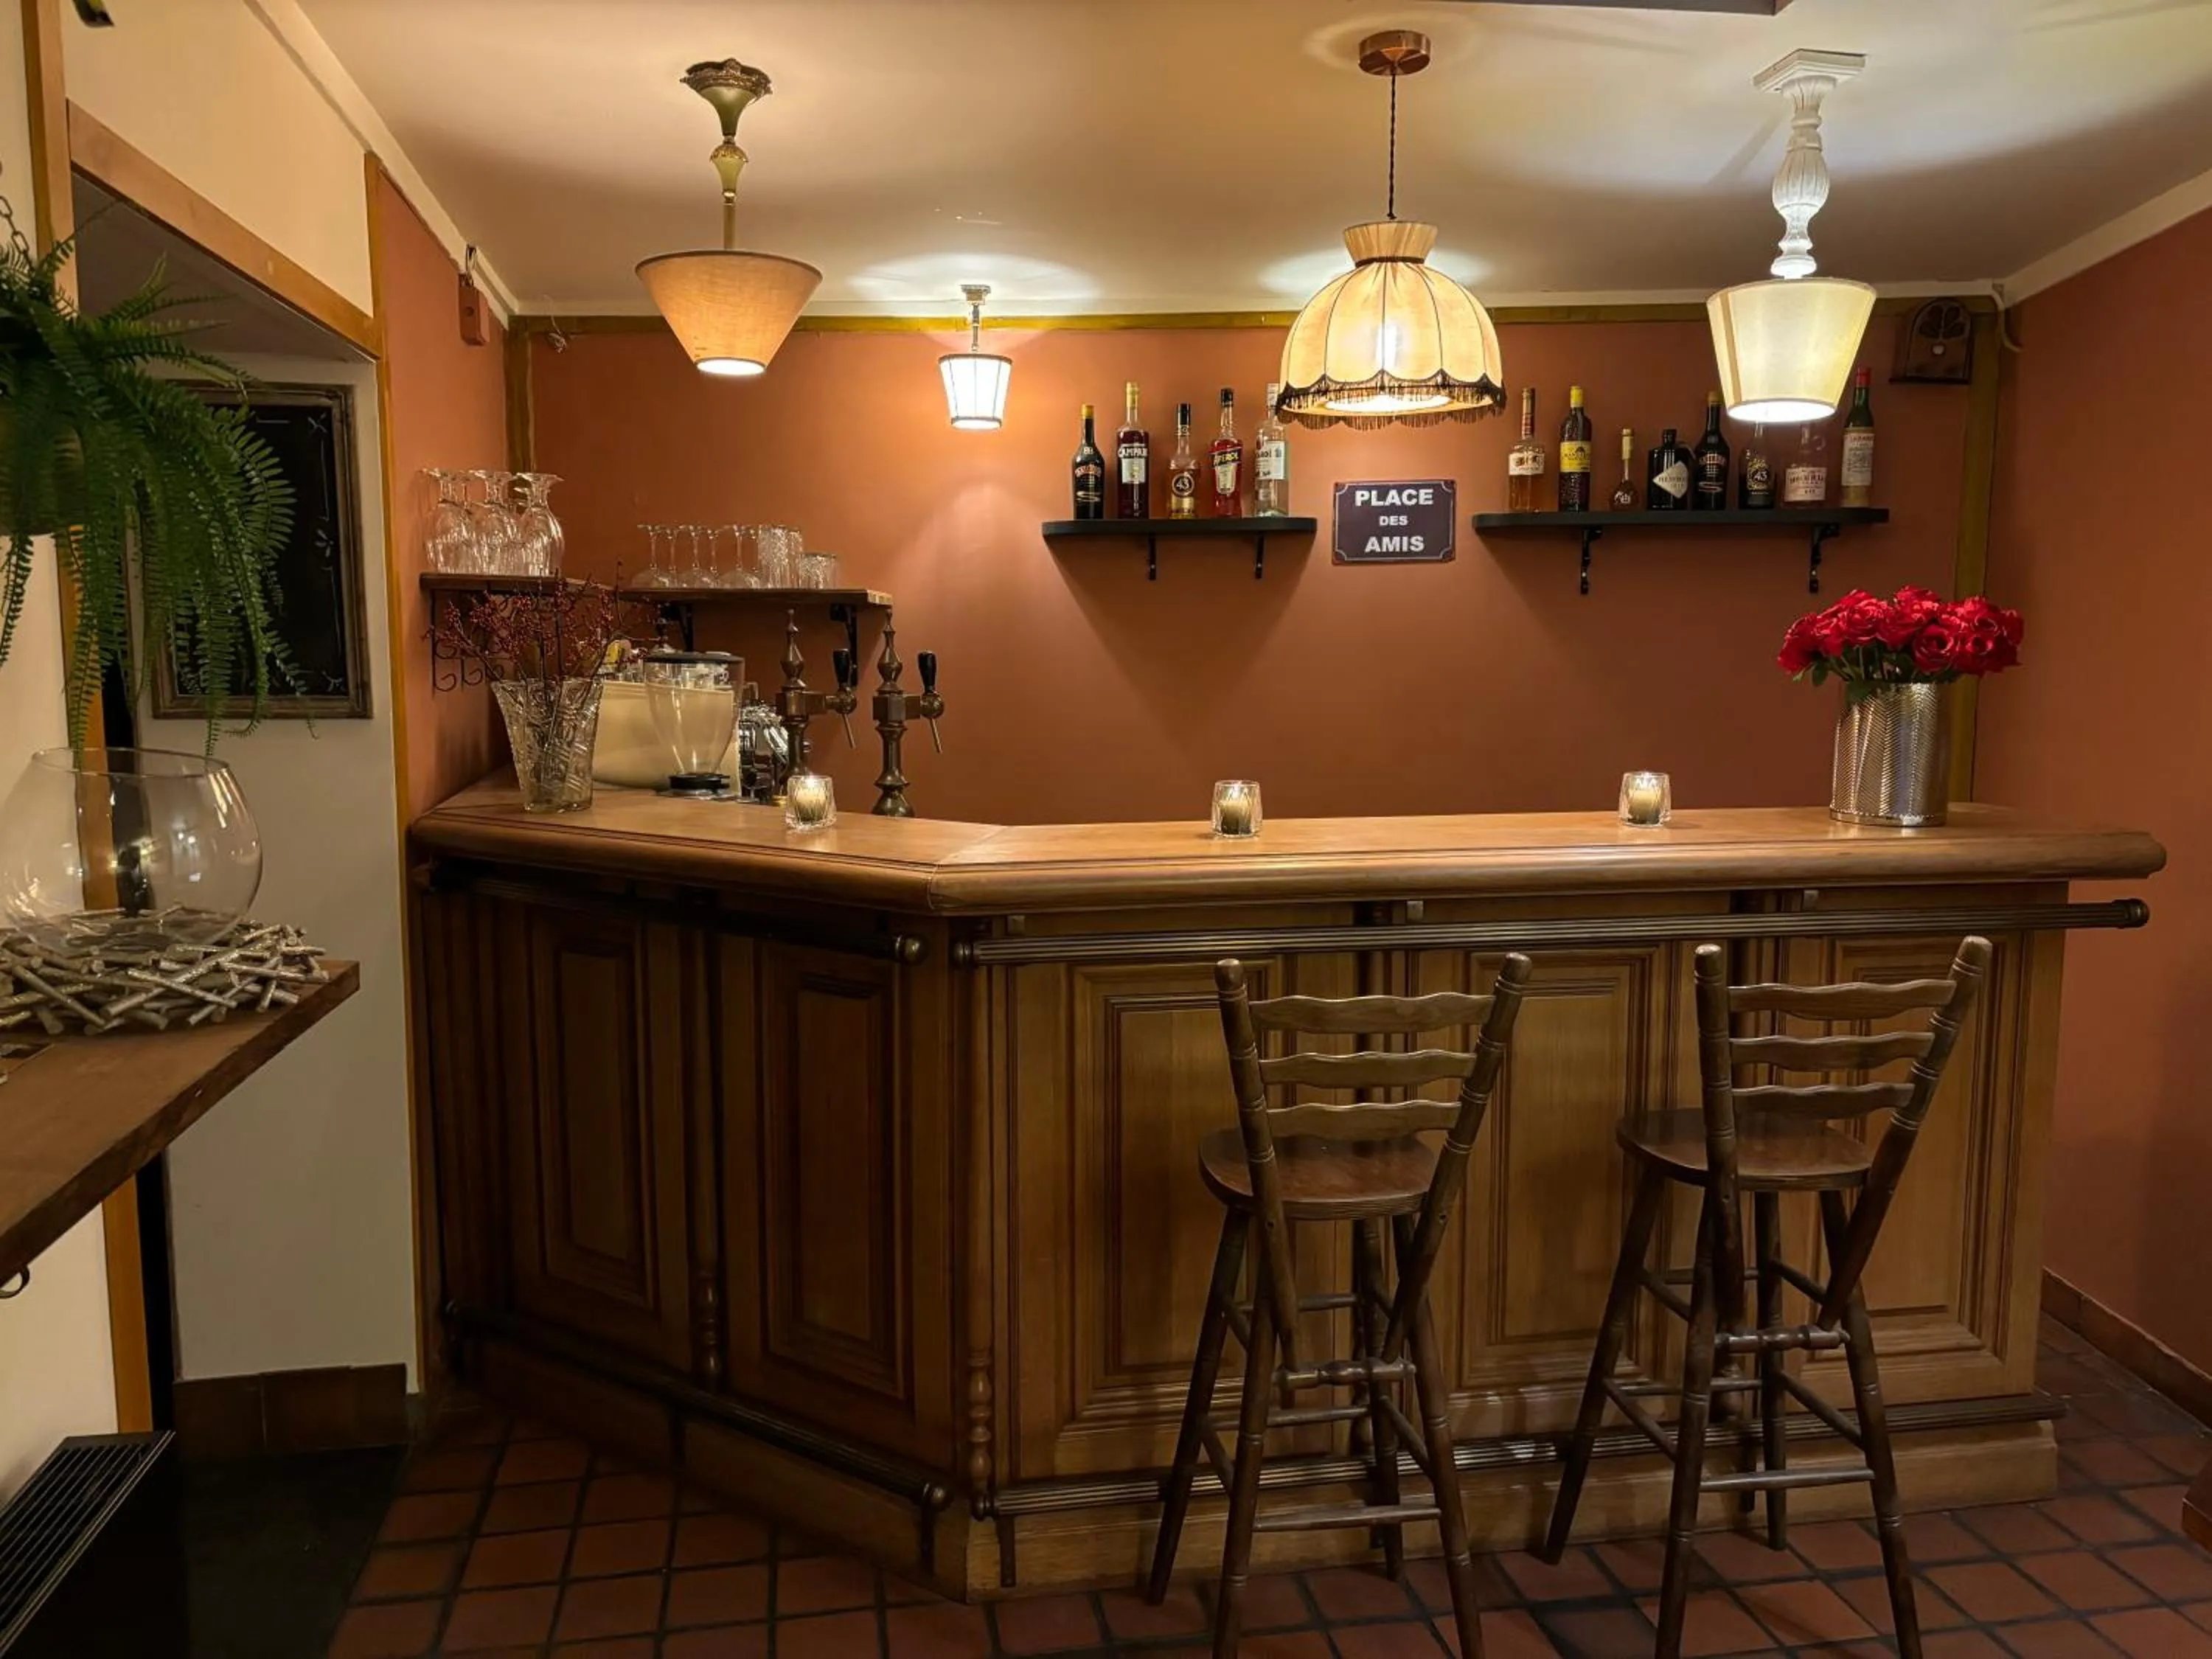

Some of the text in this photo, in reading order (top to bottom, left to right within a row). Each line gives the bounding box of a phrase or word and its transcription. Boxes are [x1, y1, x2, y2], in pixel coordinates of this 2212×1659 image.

[1118, 448, 1147, 457] CAMPARI
[1175, 480, 1190, 490] 43
[1355, 489, 1434, 507] PLACE
[1379, 515, 1408, 526] DES
[1365, 535, 1425, 552] AMIS
